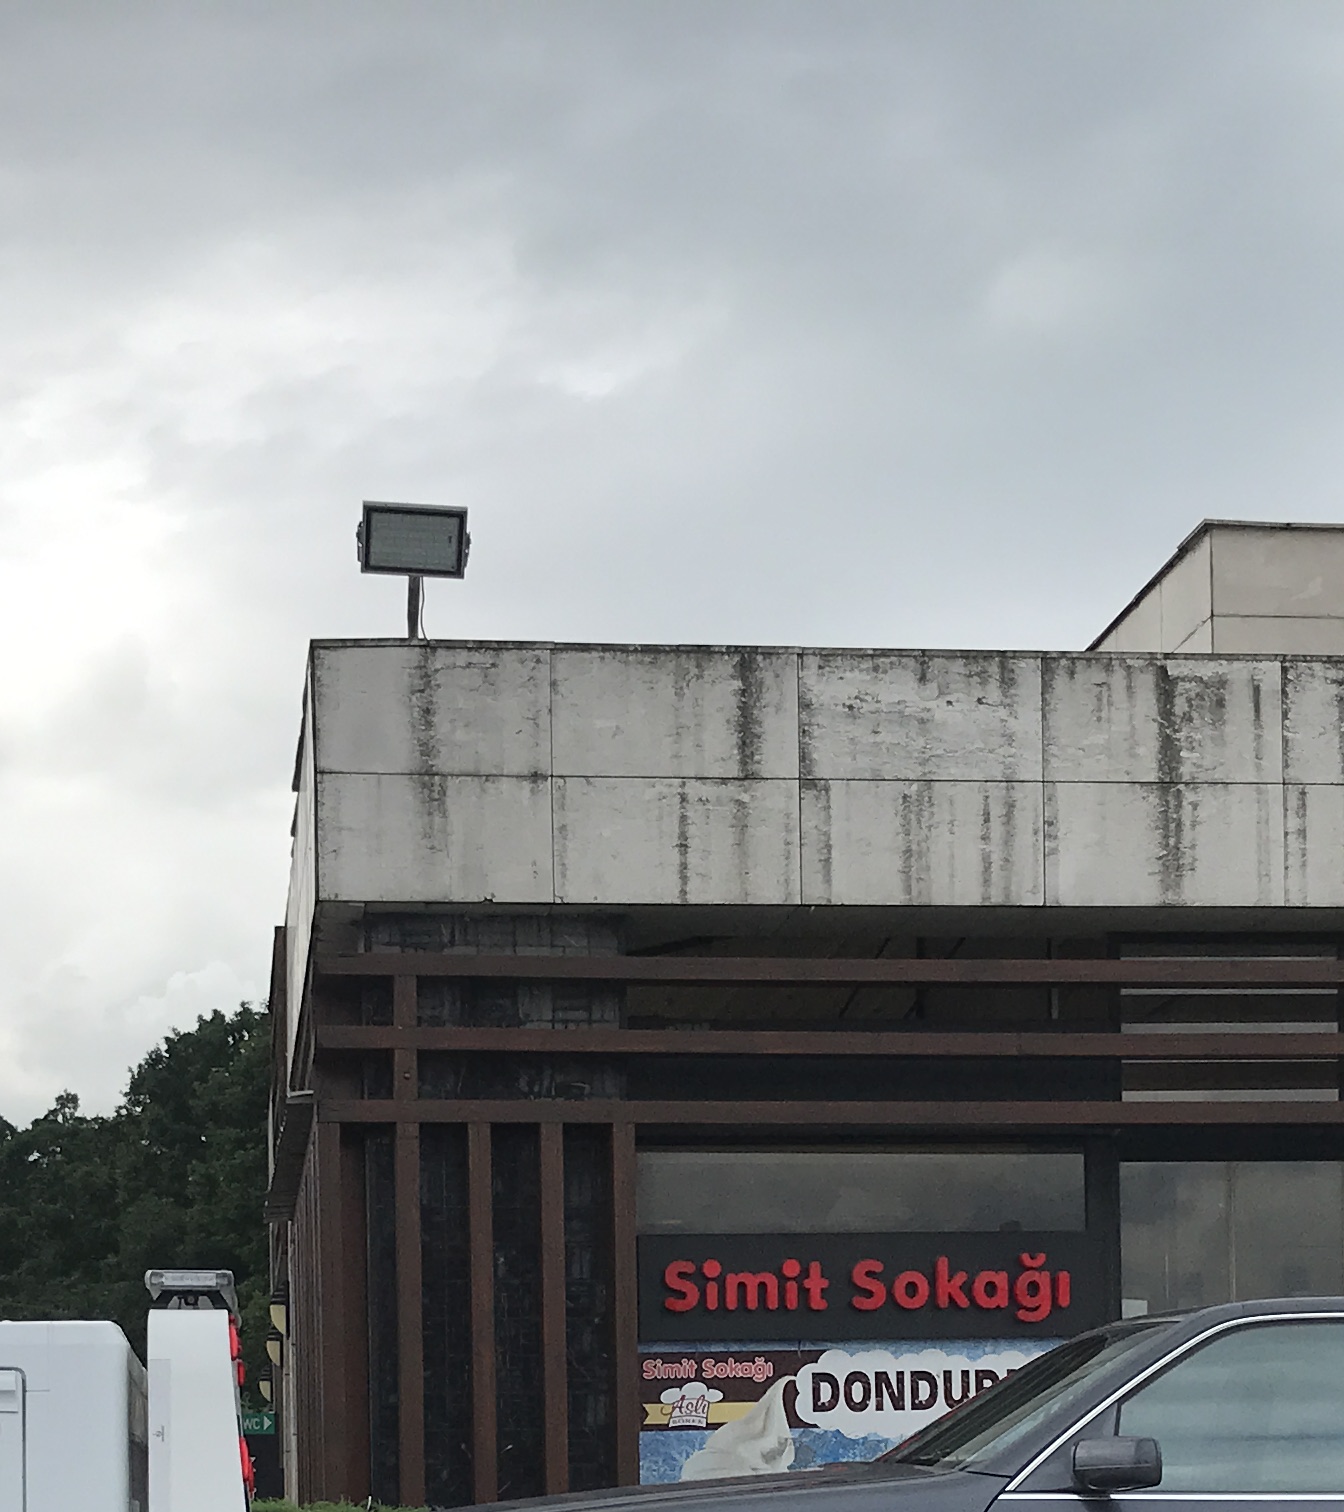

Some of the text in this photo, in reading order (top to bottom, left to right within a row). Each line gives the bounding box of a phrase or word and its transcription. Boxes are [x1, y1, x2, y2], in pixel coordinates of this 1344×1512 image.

[664, 1253, 1071, 1322] Simit Sokağı
[643, 1357, 773, 1382] Simit Sokağı
[243, 1418, 260, 1430] WC
